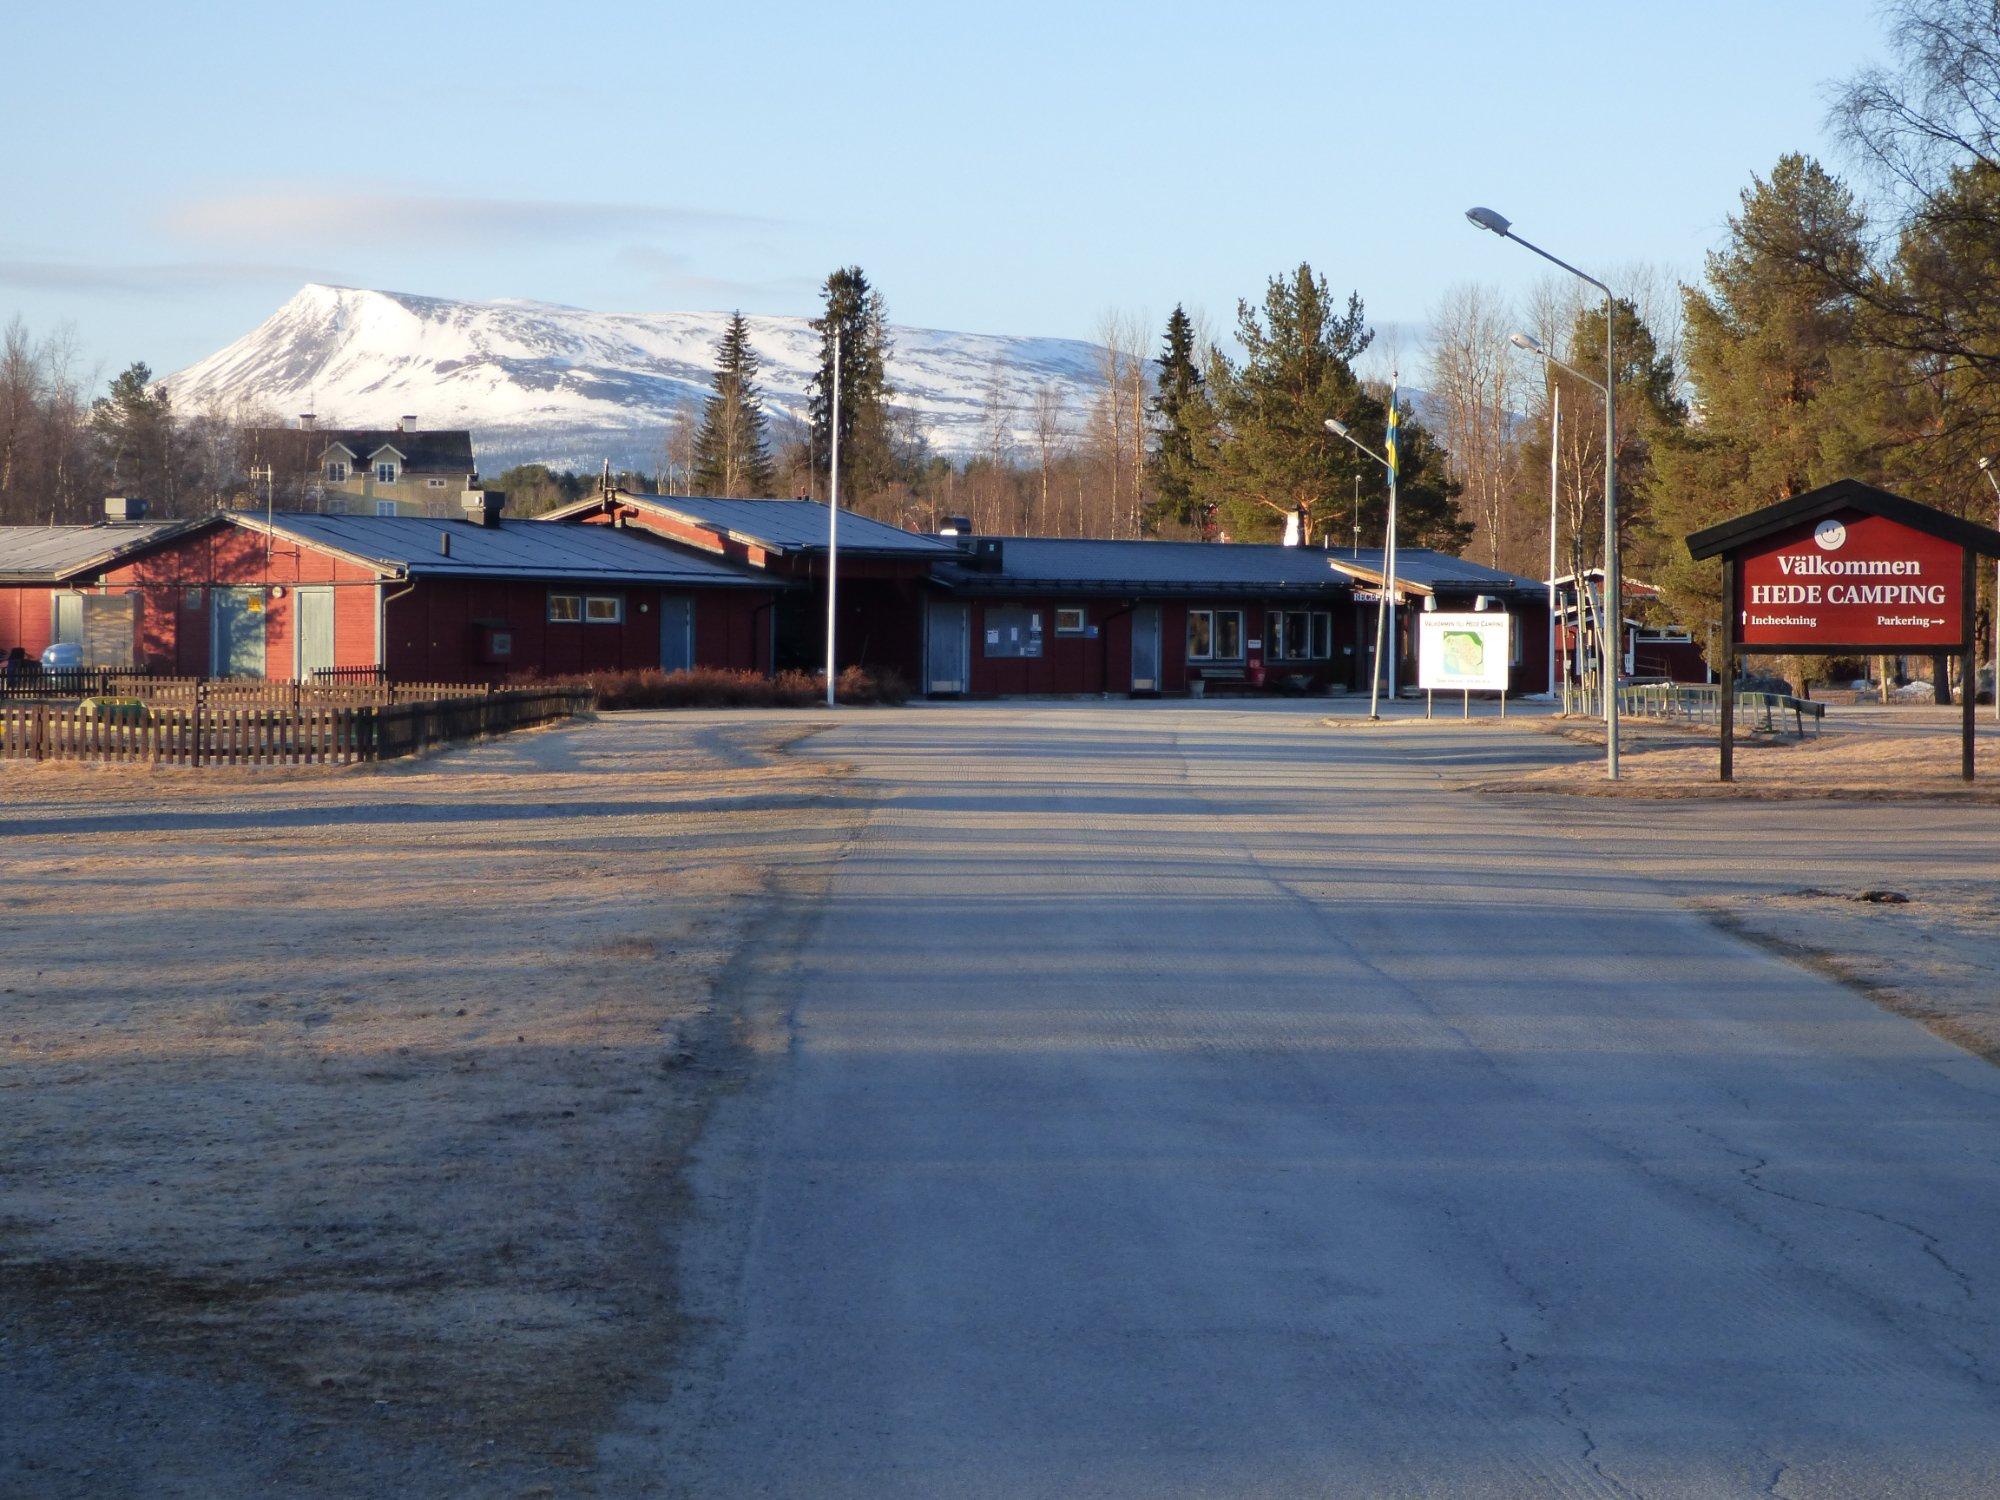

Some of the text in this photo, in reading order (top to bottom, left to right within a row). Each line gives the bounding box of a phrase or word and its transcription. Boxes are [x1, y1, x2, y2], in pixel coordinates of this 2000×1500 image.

[1777, 555, 1921, 575] Välkommen
[1751, 585, 1946, 605] HEDE CAMPING
[1751, 615, 1817, 628] Incheckning
[1877, 615, 1930, 628] Parkering
